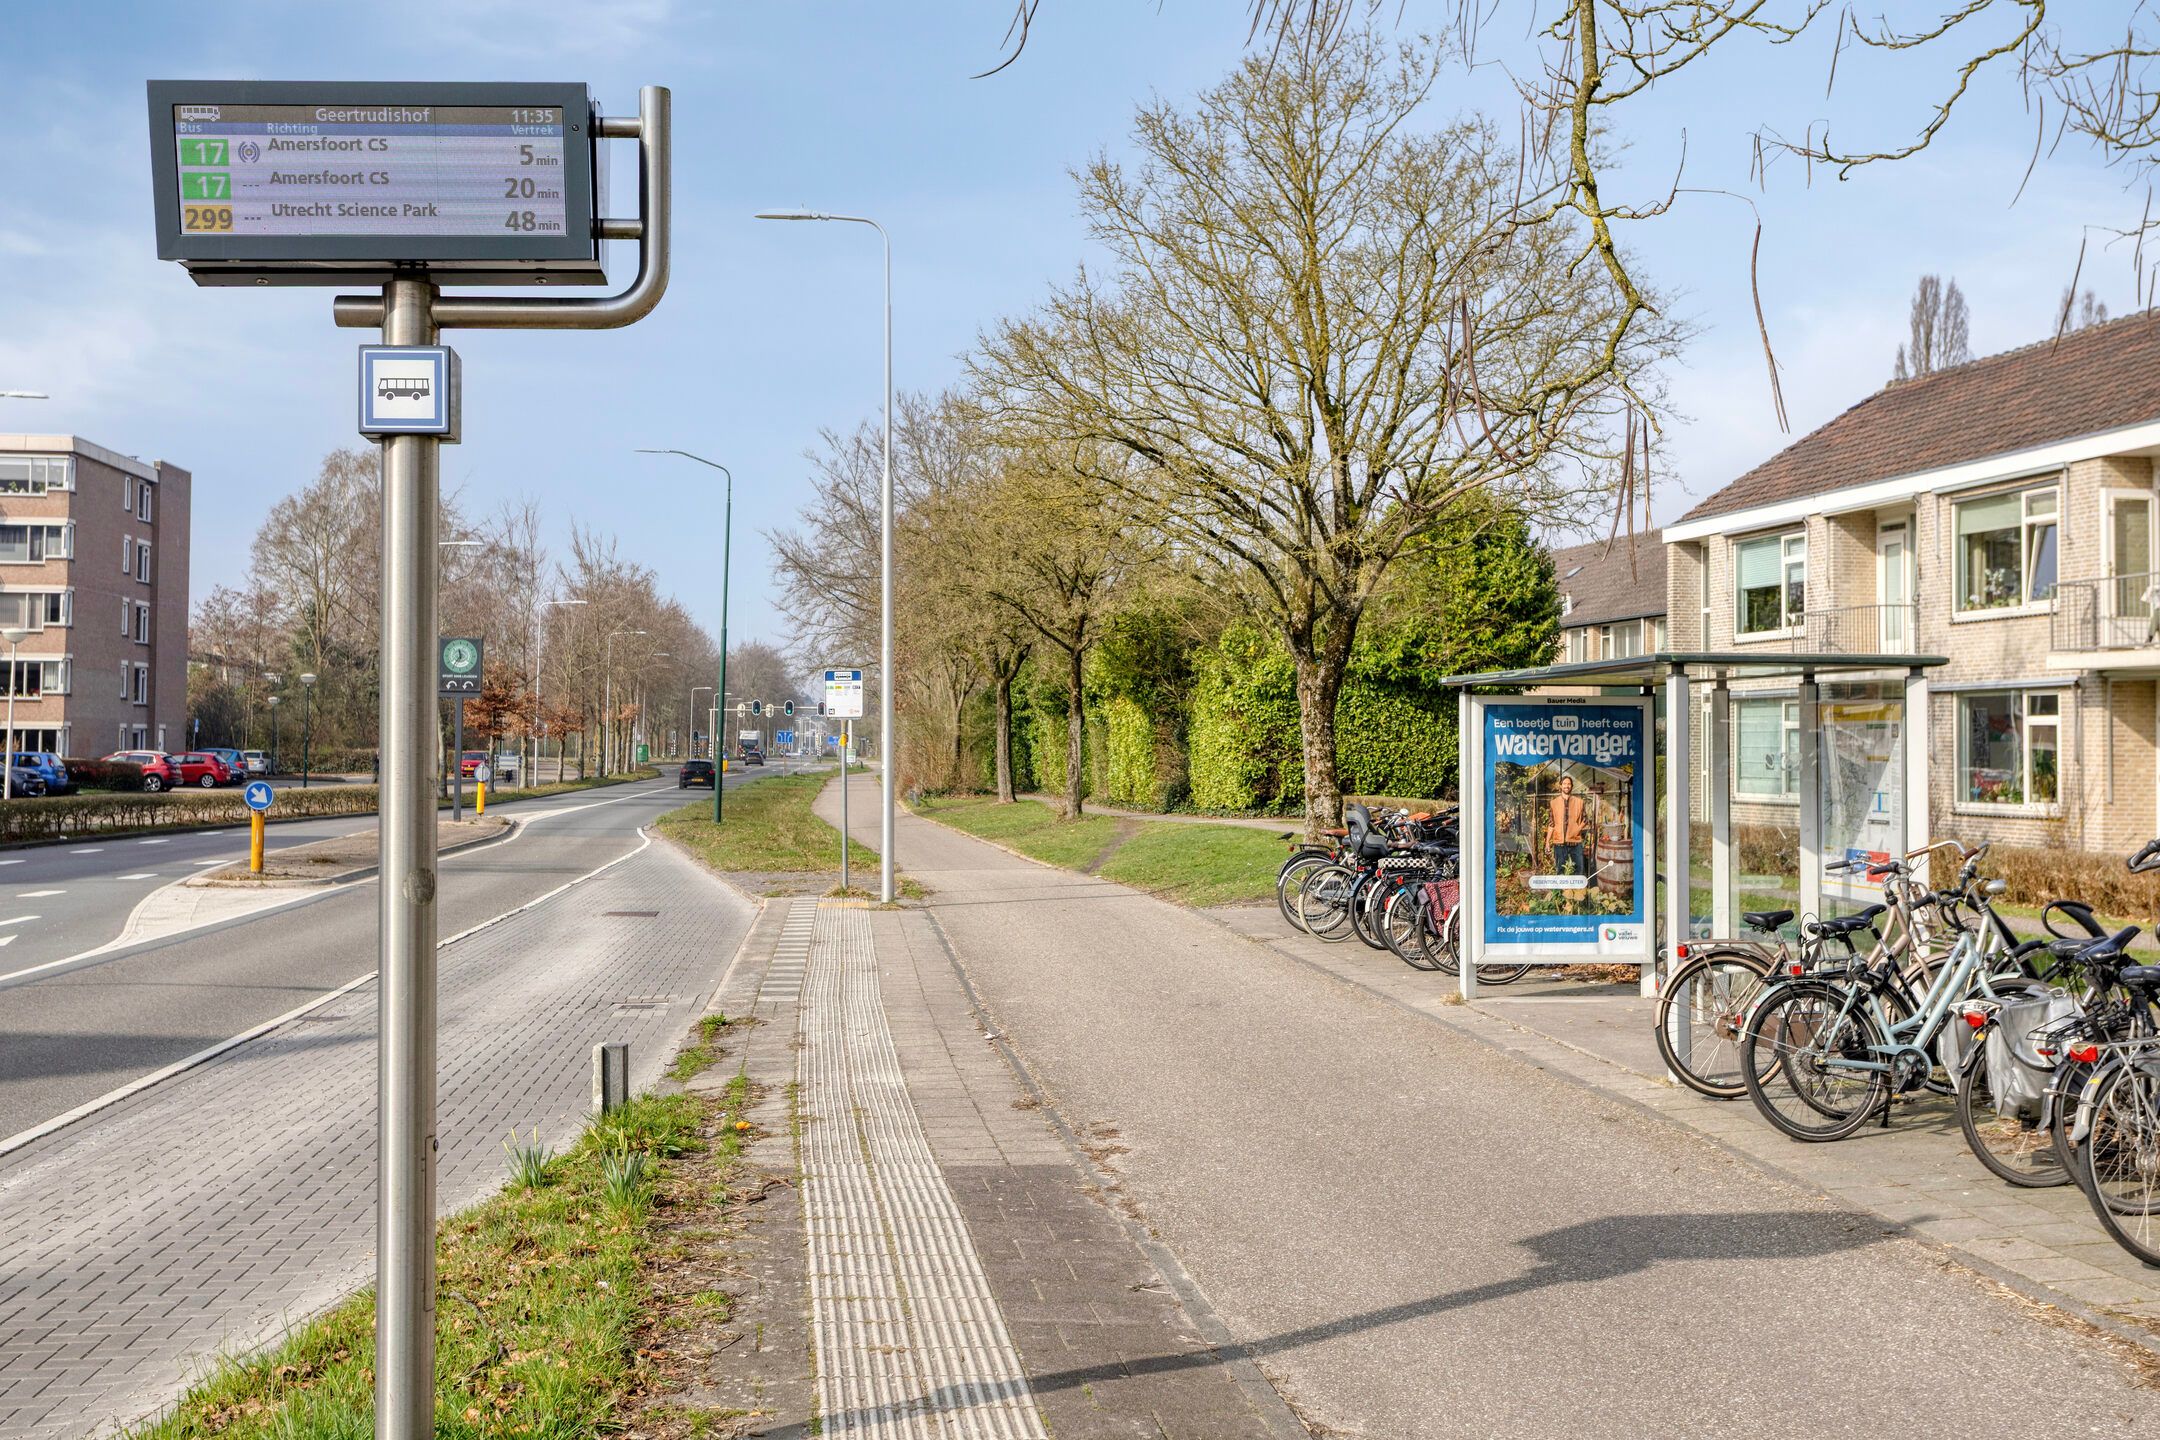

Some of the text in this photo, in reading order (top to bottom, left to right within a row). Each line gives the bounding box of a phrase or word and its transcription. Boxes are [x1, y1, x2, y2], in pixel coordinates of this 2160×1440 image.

[315, 107, 430, 122] Geertrudishof
[512, 110, 553, 123] 11:35
[180, 122, 202, 133] Bus
[267, 122, 318, 136] Richting
[511, 125, 554, 135] Vertrek
[268, 137, 388, 151] Amersfoort CS
[195, 142, 224, 164] 17
[520, 144, 558, 166] 5 min
[270, 170, 390, 185] Amersfoort CS
[197, 175, 226, 198] 17
[504, 177, 559, 199] 20 min
[271, 202, 438, 217] Utrecht Science Park
[185, 208, 233, 230] 299
[505, 211, 560, 232] 48 min
[1494, 717, 1633, 730] Een beetje tuin heeft een
[1543, 926, 1594, 934] watervangers.nl
